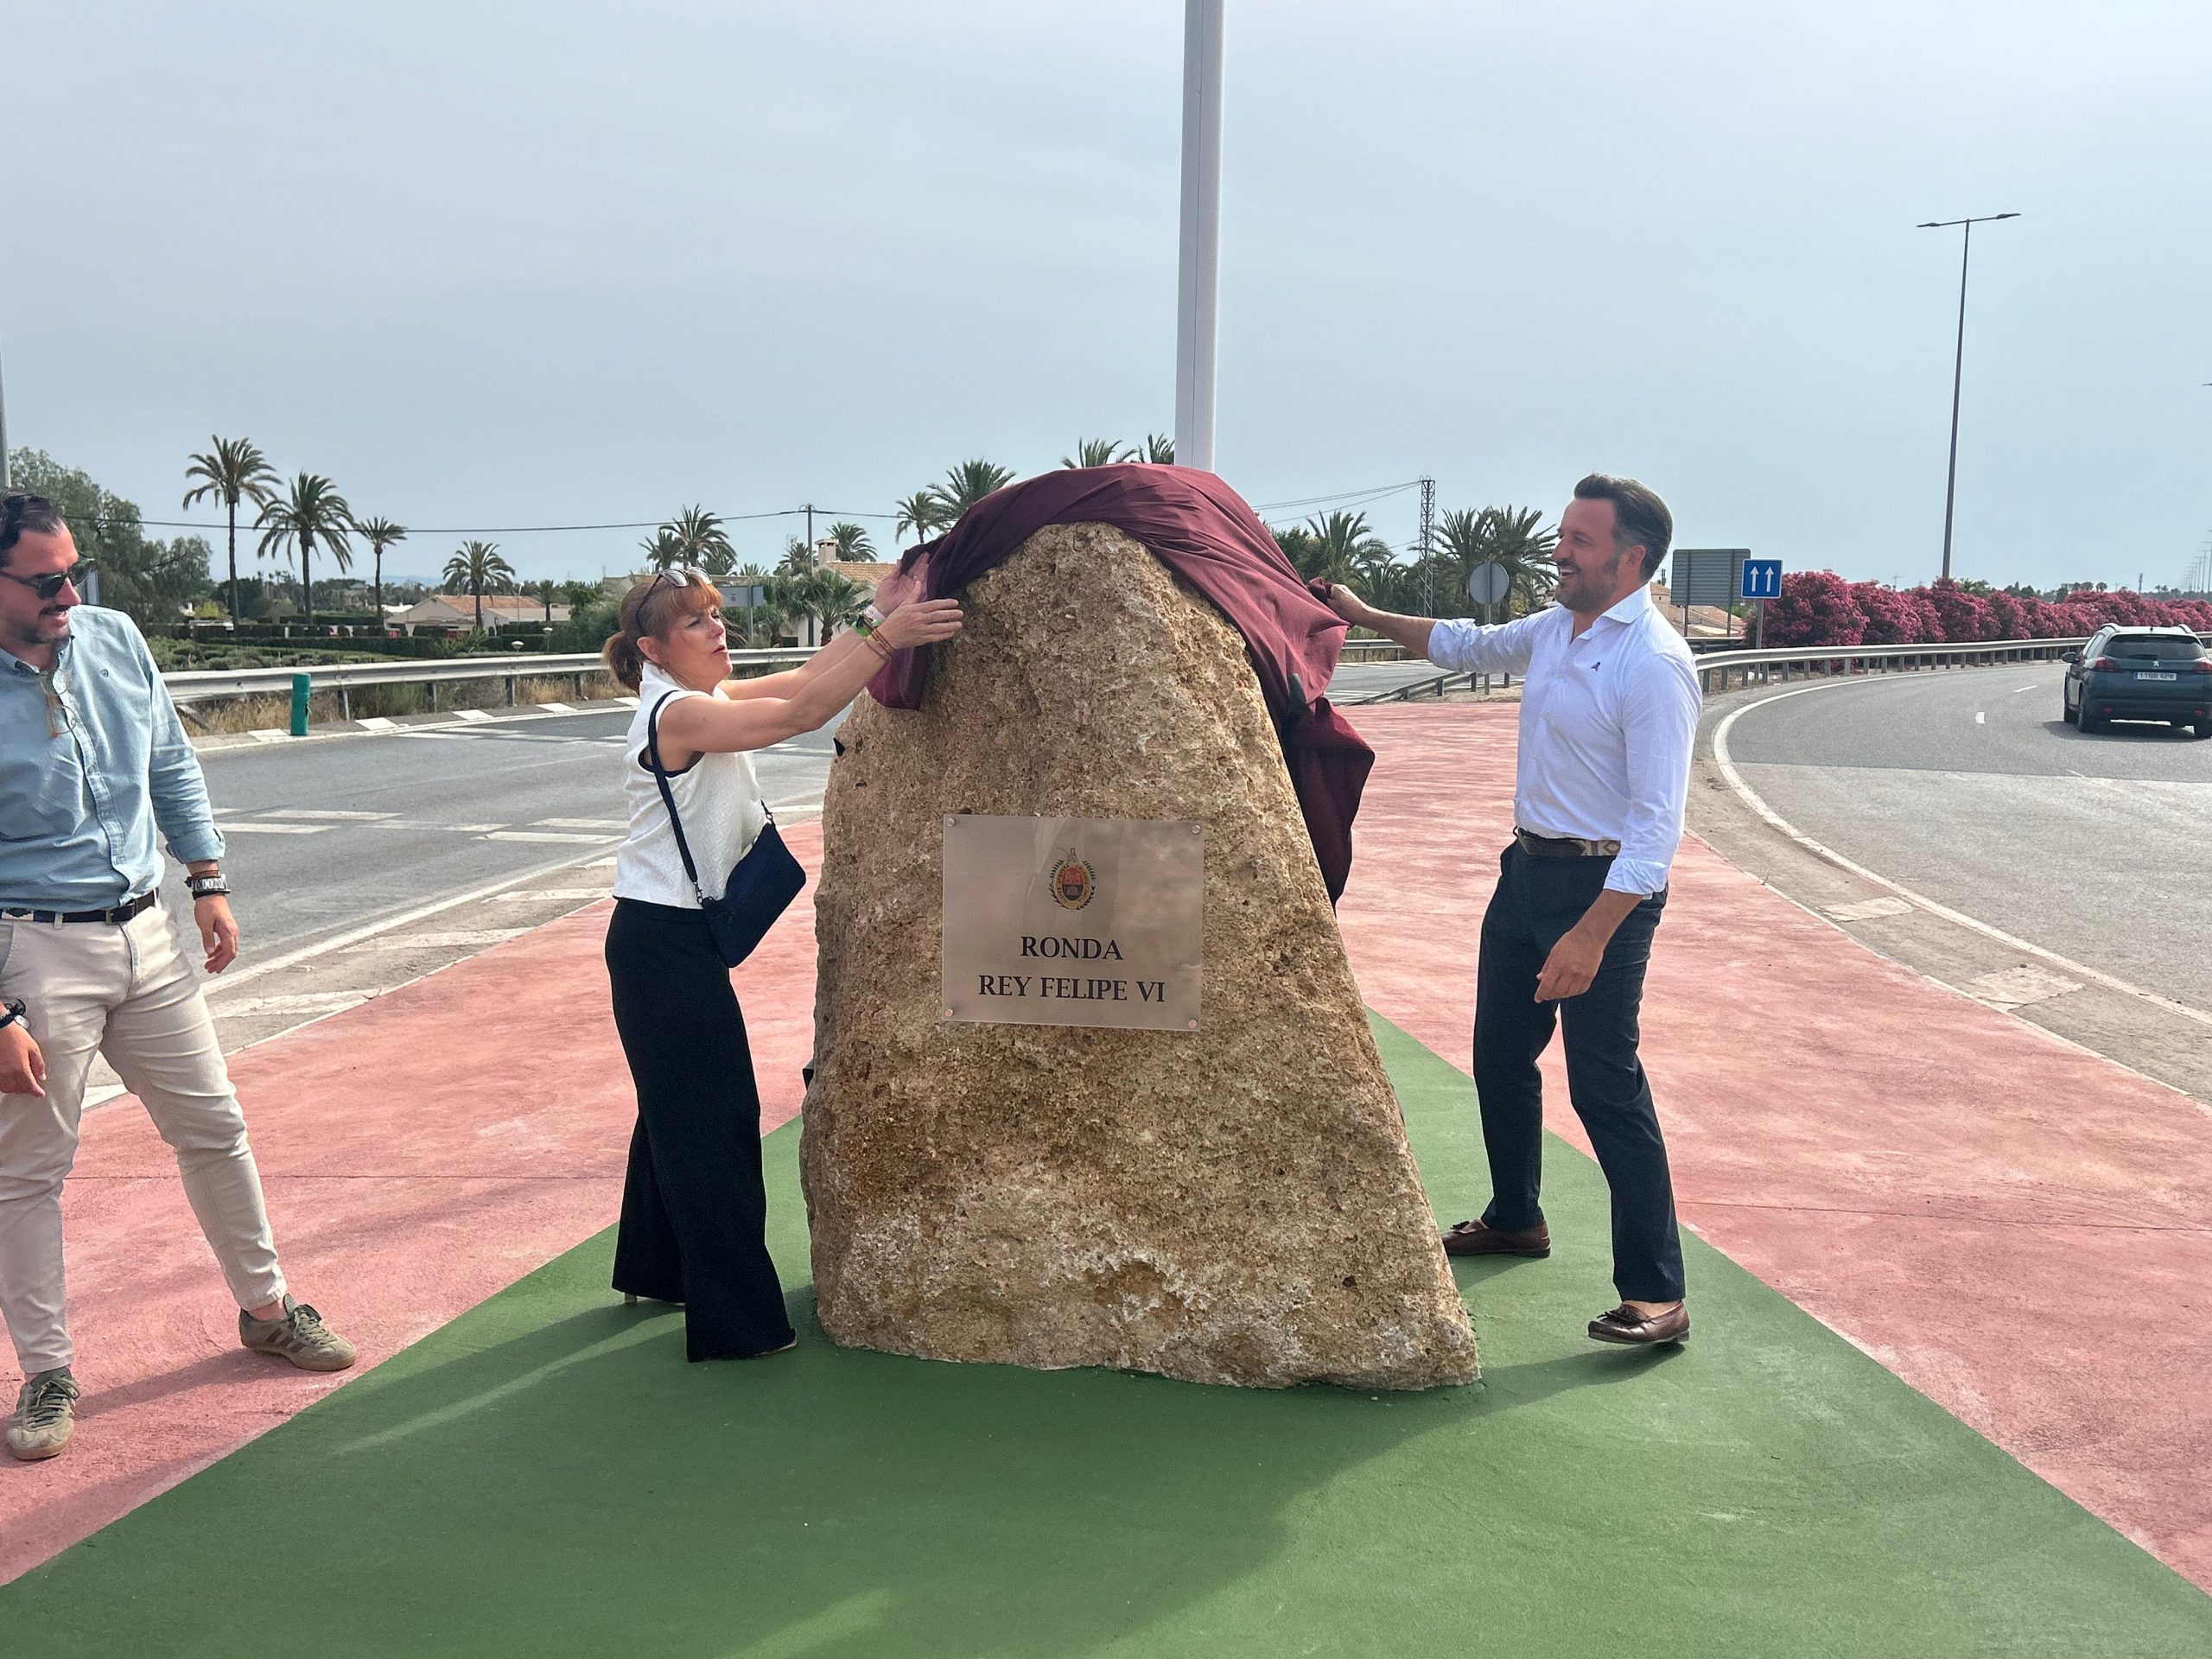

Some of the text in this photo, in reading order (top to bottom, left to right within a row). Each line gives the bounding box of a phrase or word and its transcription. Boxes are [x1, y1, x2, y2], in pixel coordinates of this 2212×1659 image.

[1020, 936, 1123, 961] RONDA
[978, 975, 1166, 1002] REY FELIPE VI
